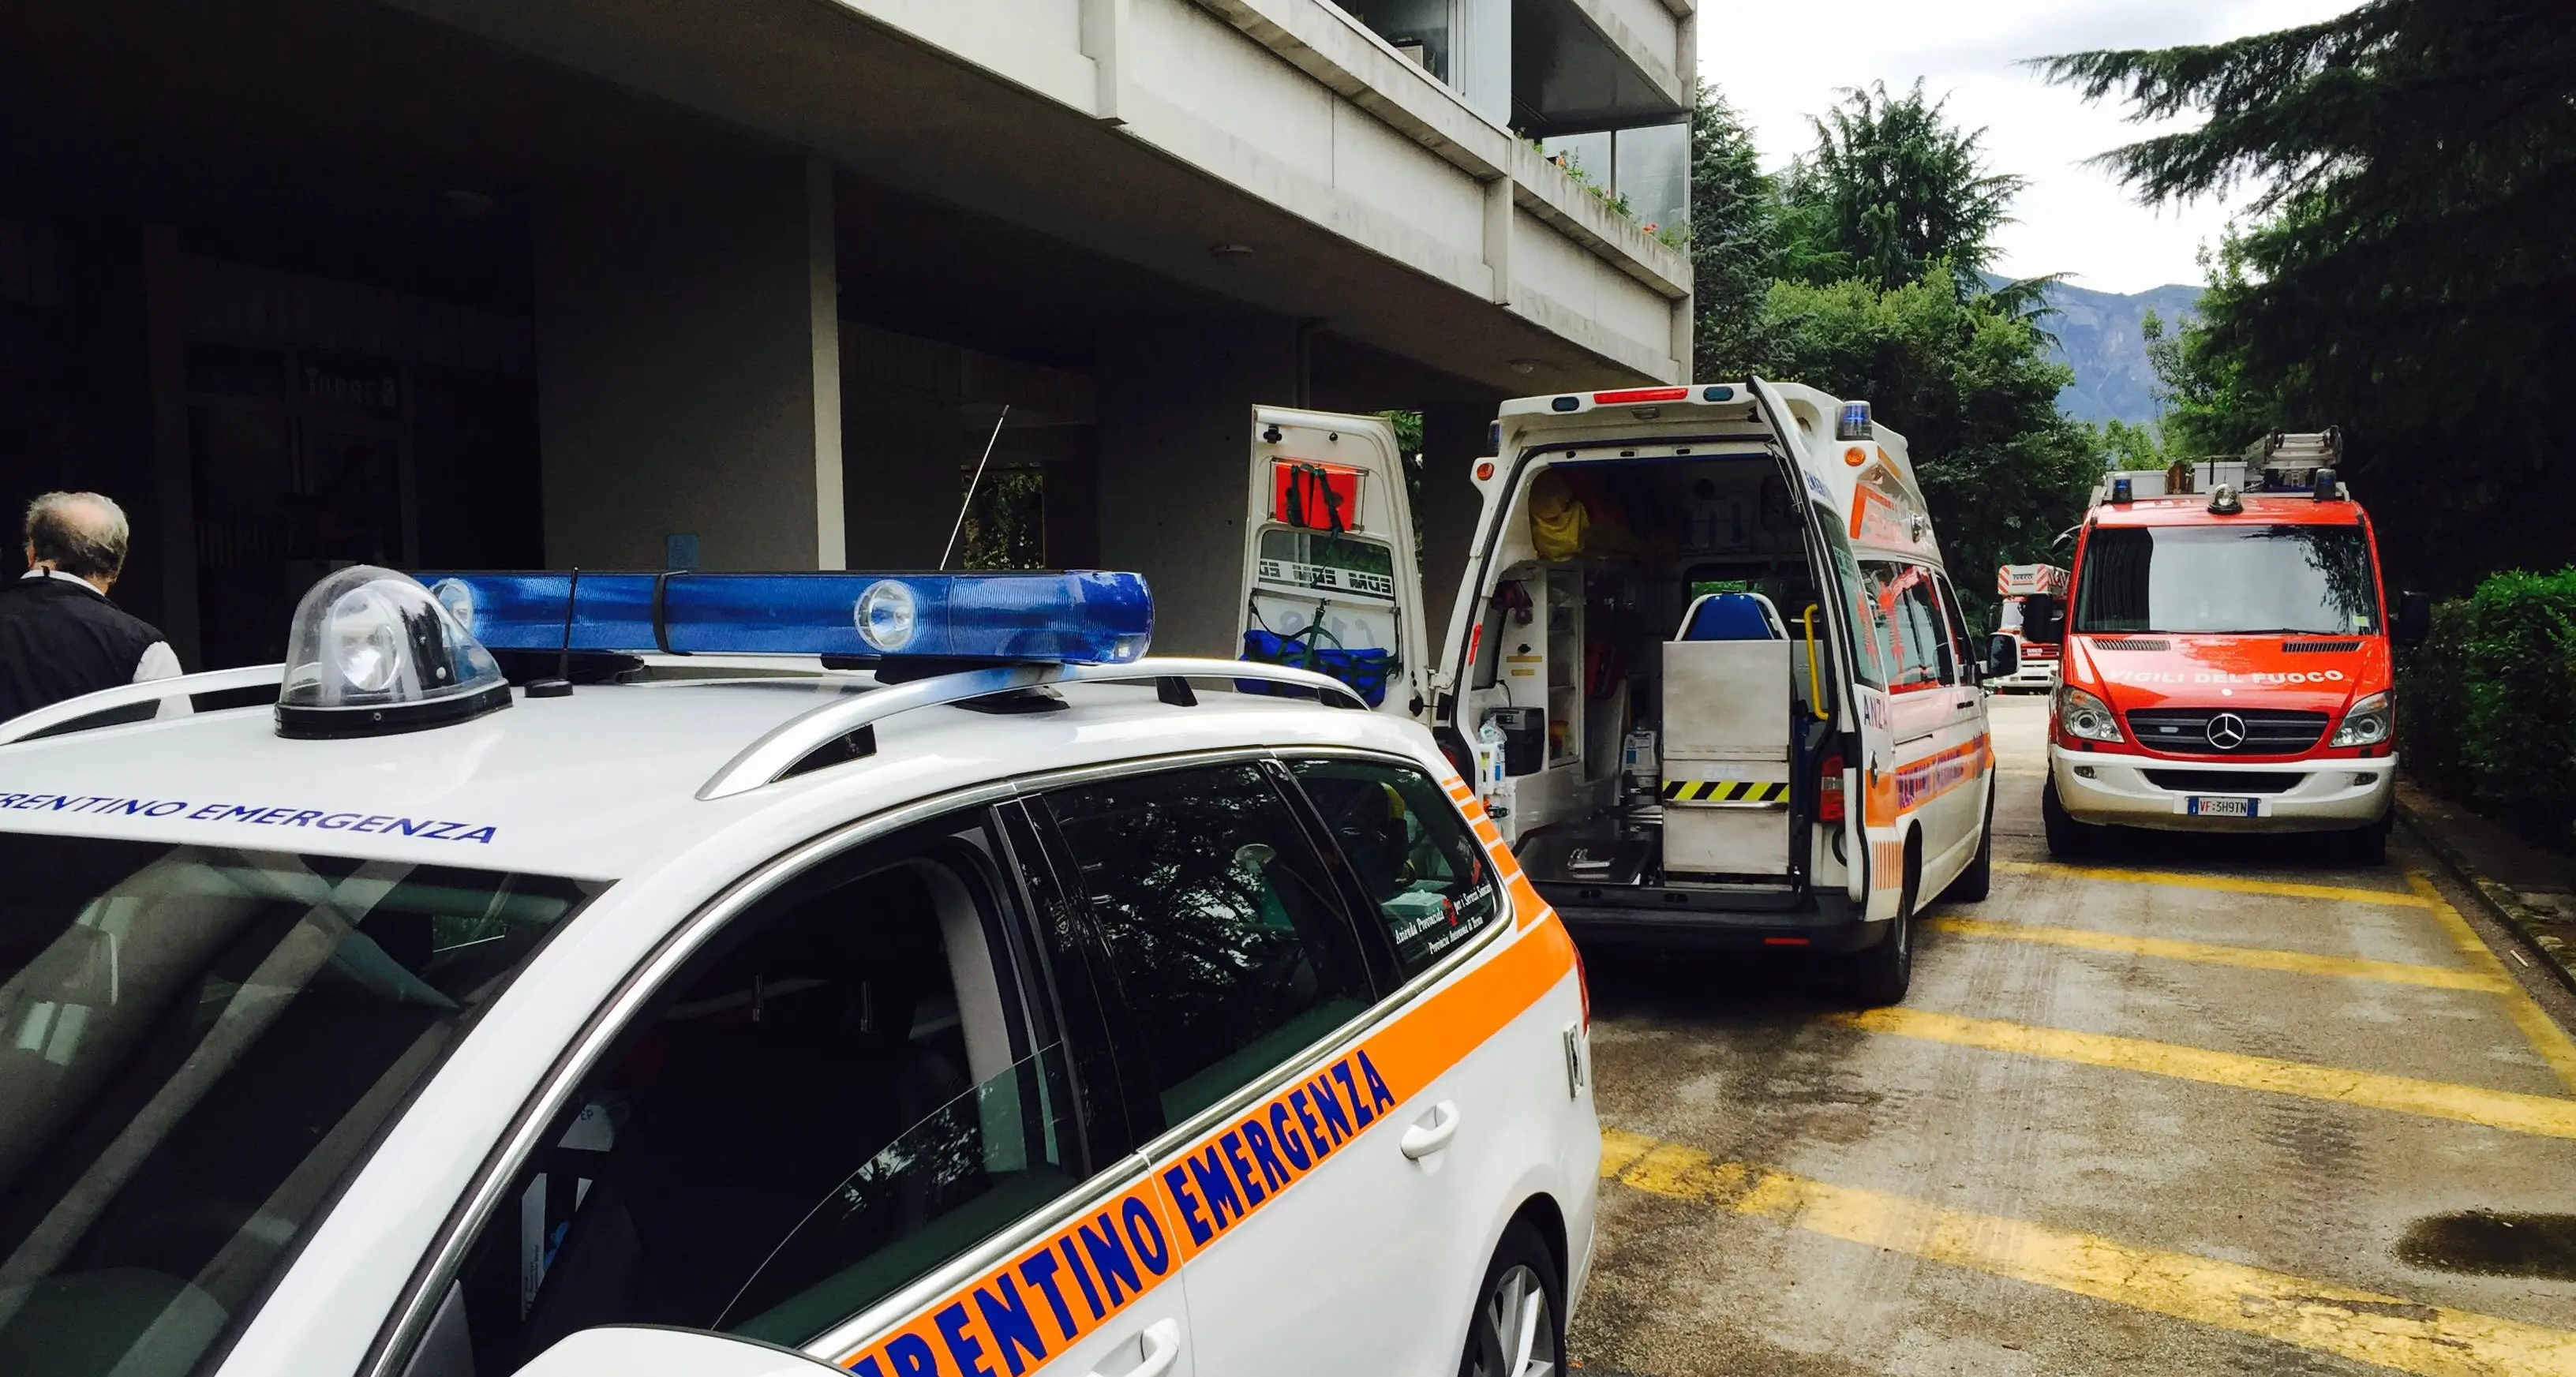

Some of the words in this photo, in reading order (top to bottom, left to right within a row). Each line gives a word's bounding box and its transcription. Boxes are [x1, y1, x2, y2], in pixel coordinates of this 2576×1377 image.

[2109, 669, 2185, 683] VIGILI
[2194, 672, 2245, 683] DEL
[2252, 669, 2344, 684] FUOCO
[0, 793, 188, 816] RENTINO
[185, 804, 498, 844] EMERGENZA
[1163, 1049, 1395, 1248] EMERGENZA
